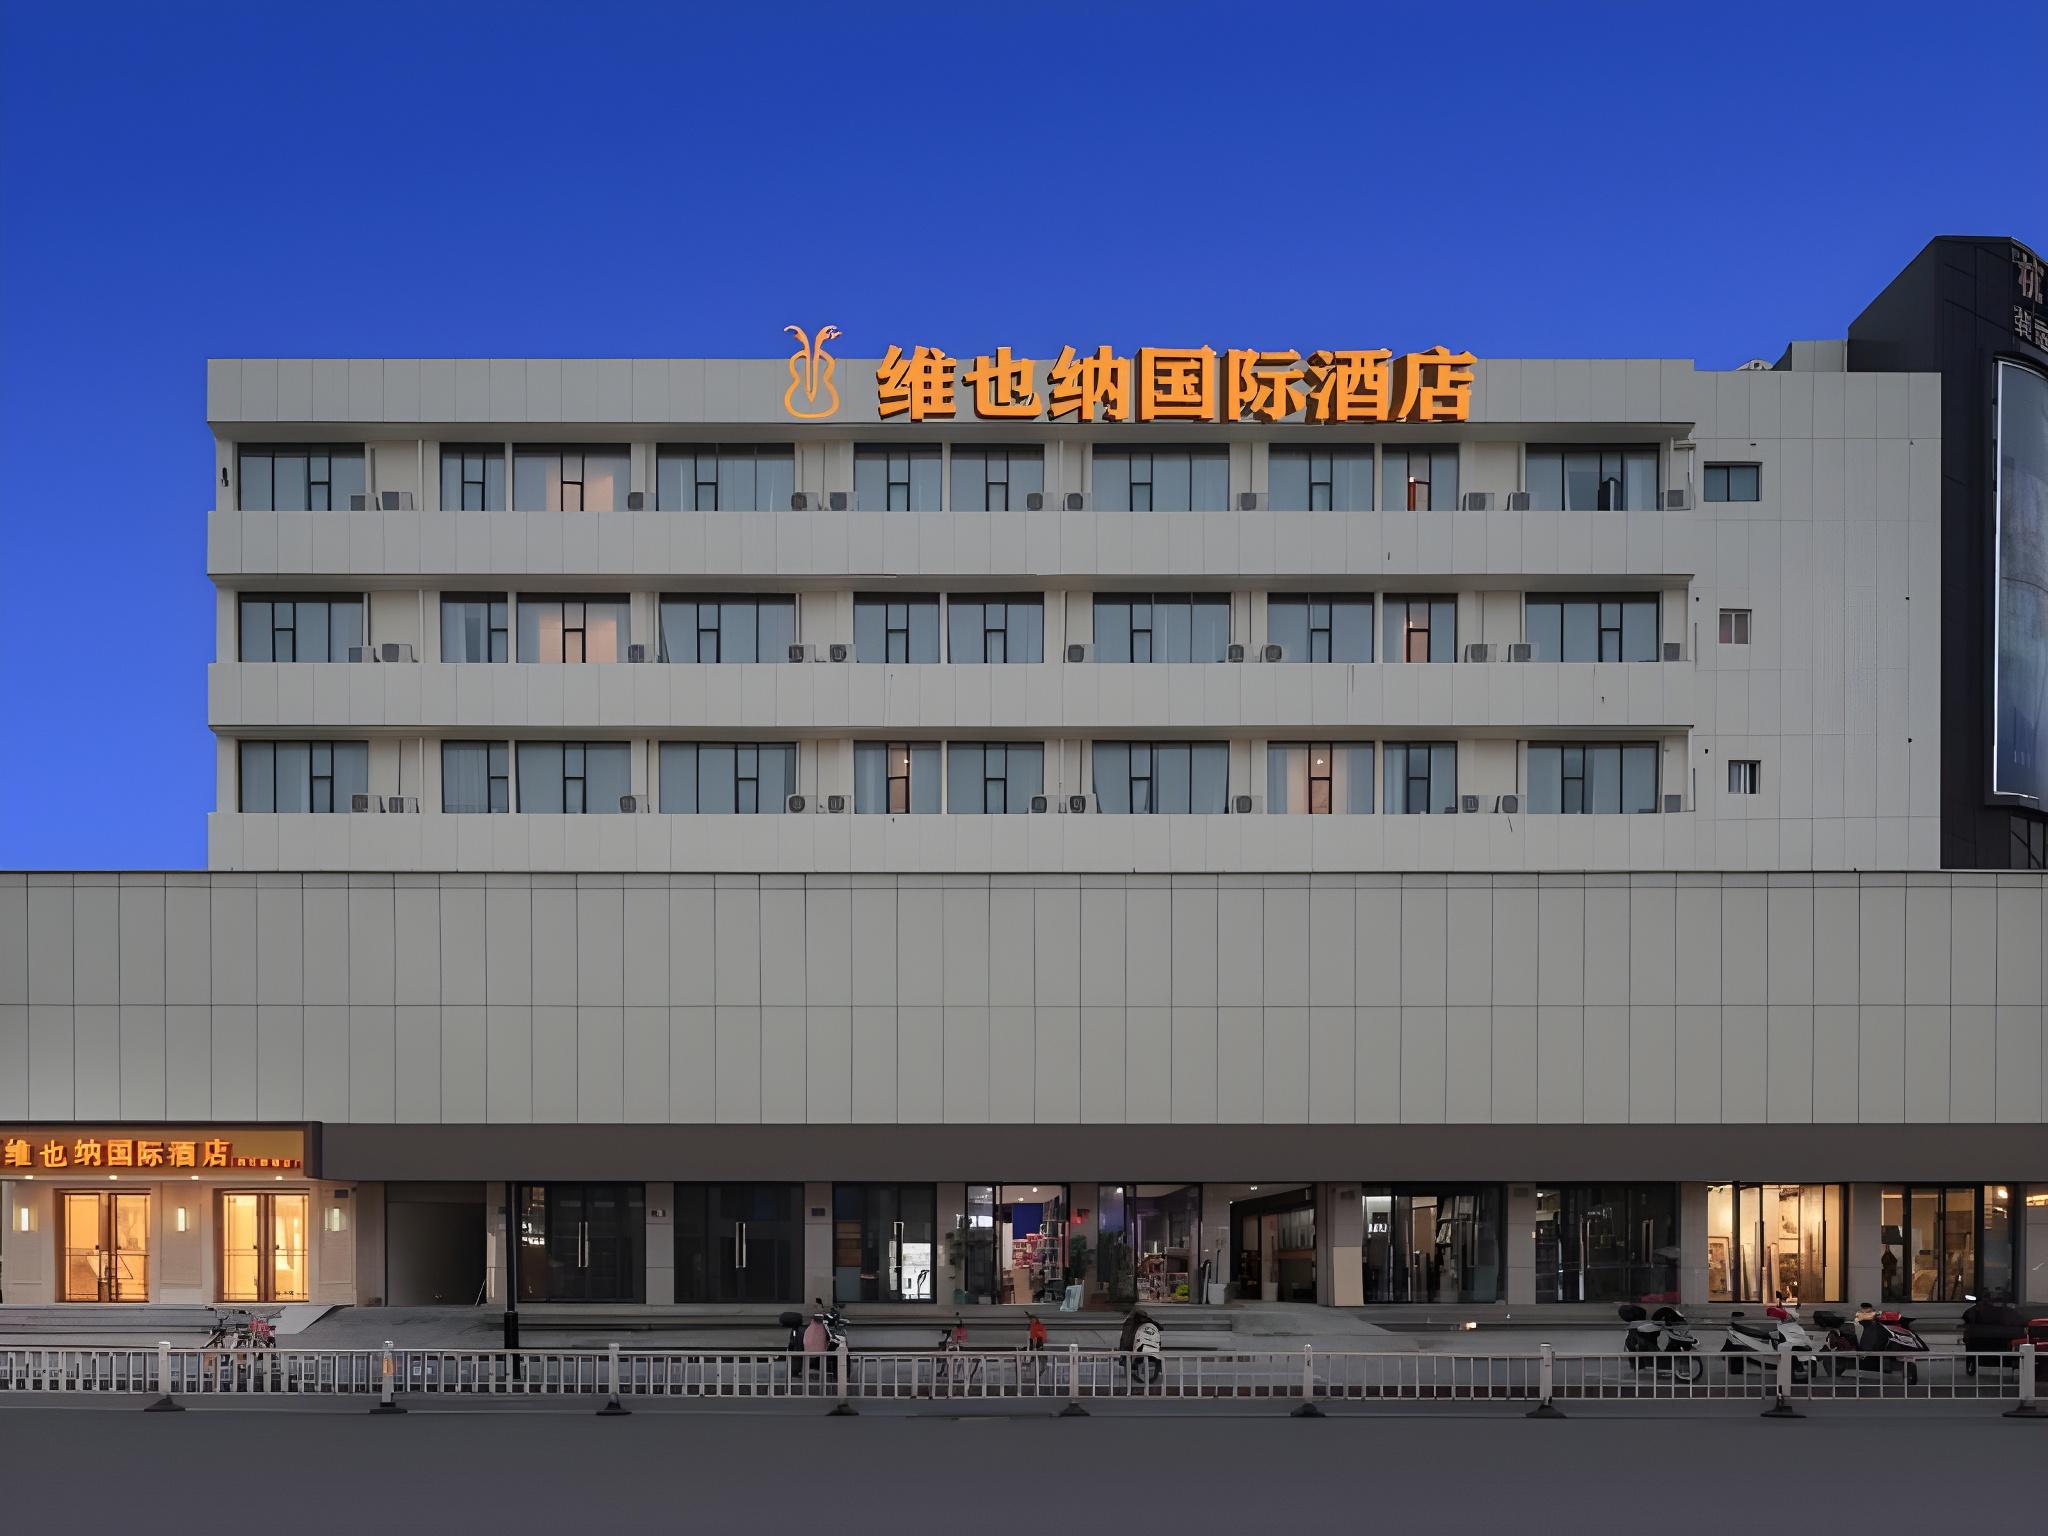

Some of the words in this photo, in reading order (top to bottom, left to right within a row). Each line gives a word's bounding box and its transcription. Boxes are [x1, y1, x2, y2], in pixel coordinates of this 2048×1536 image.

[877, 346, 1477, 421] 维也纳国际酒店
[4, 1138, 232, 1168] 维也纳国际酒店
